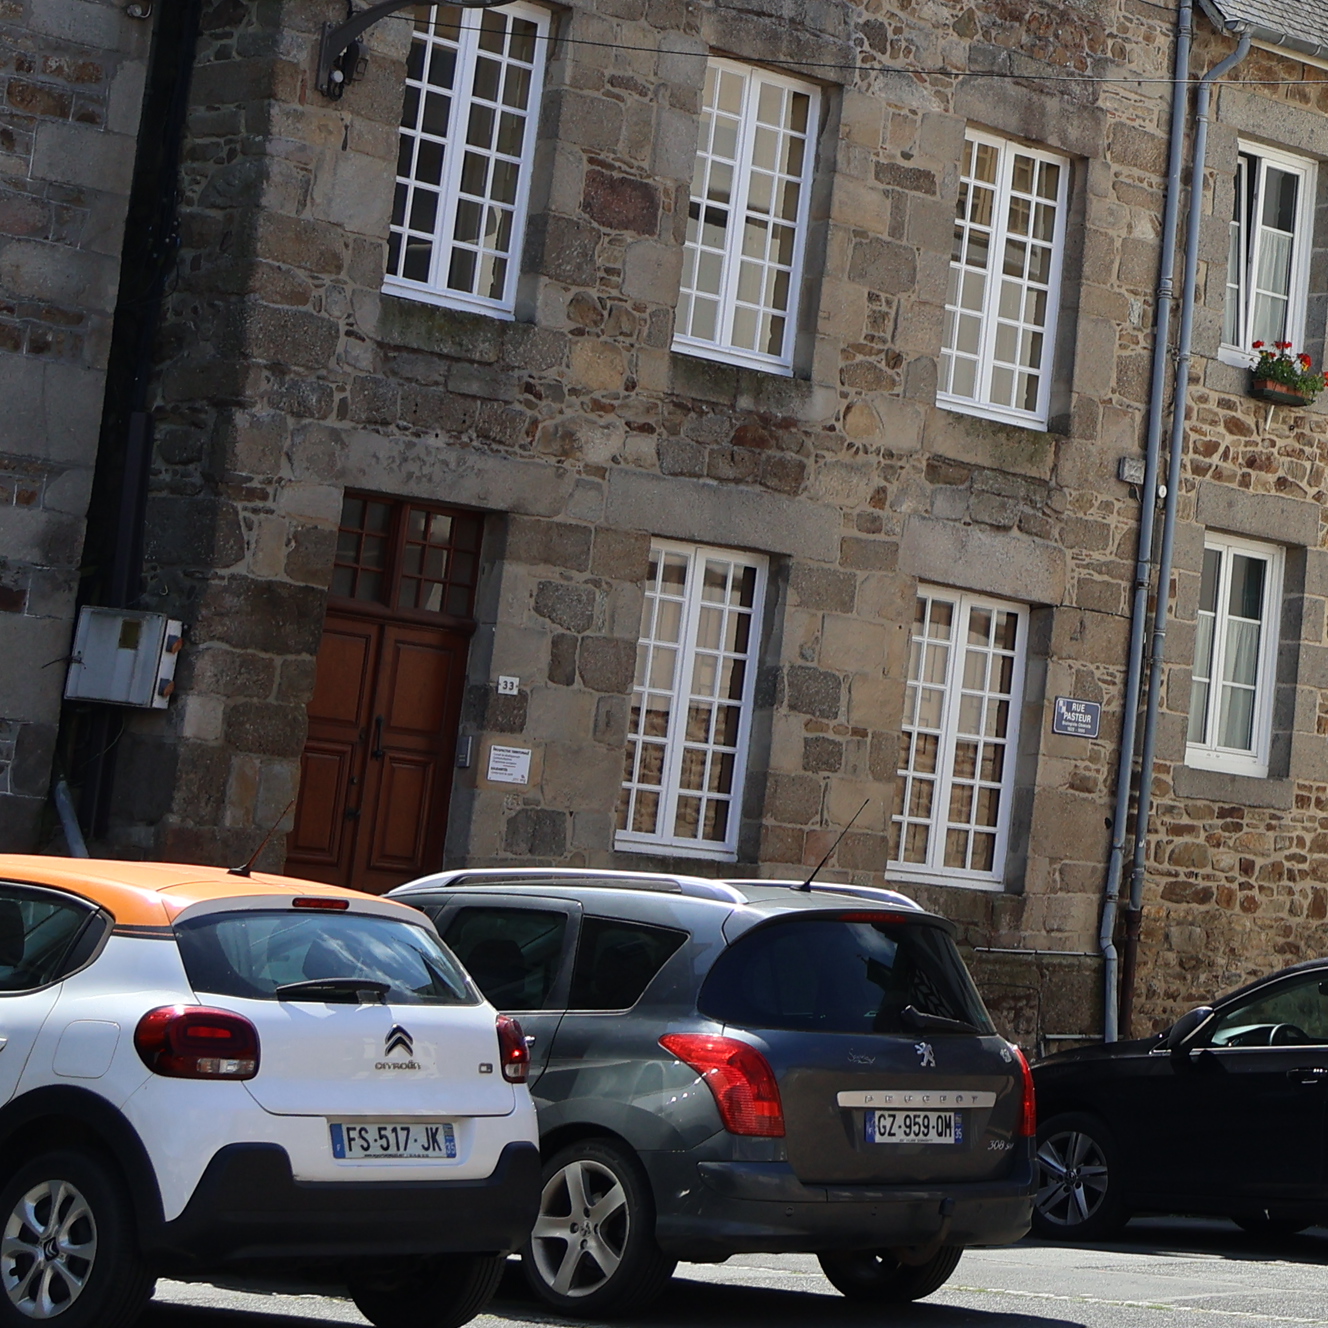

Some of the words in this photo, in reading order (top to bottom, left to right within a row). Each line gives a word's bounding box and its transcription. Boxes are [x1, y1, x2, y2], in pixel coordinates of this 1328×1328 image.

[502, 680, 514, 691] 33
[1072, 703, 1085, 712] RUE
[1063, 712, 1091, 723] PASTEUR
[987, 1140, 1004, 1150] 308
